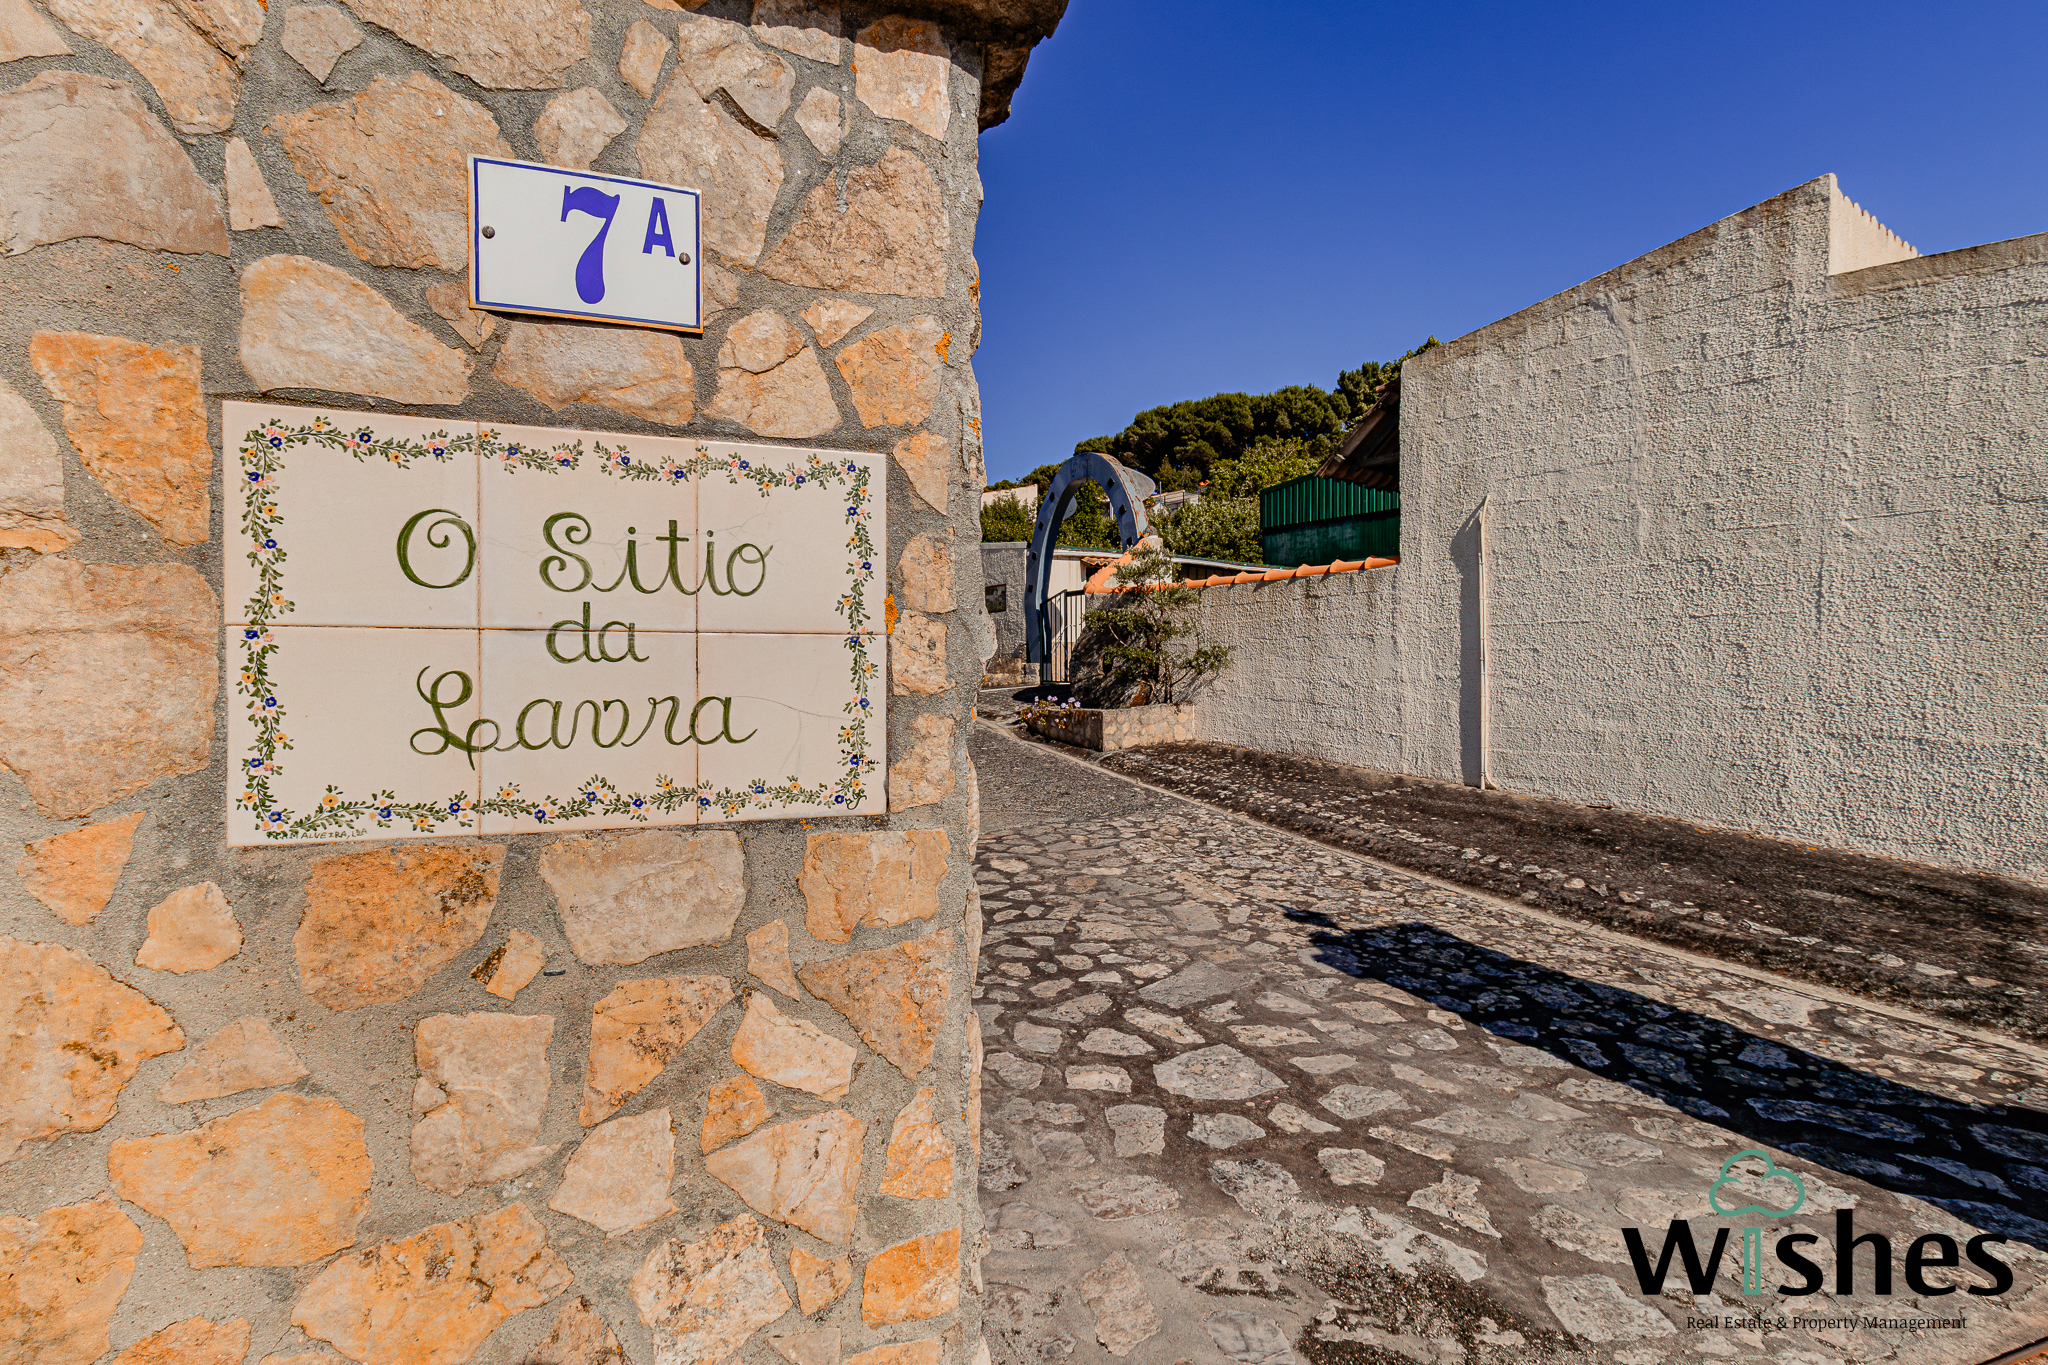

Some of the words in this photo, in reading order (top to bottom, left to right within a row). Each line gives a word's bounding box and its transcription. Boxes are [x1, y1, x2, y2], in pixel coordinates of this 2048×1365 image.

[396, 508, 477, 589] O
[538, 511, 774, 597] Sitio
[545, 601, 651, 664] da
[409, 665, 758, 770] Lavra
